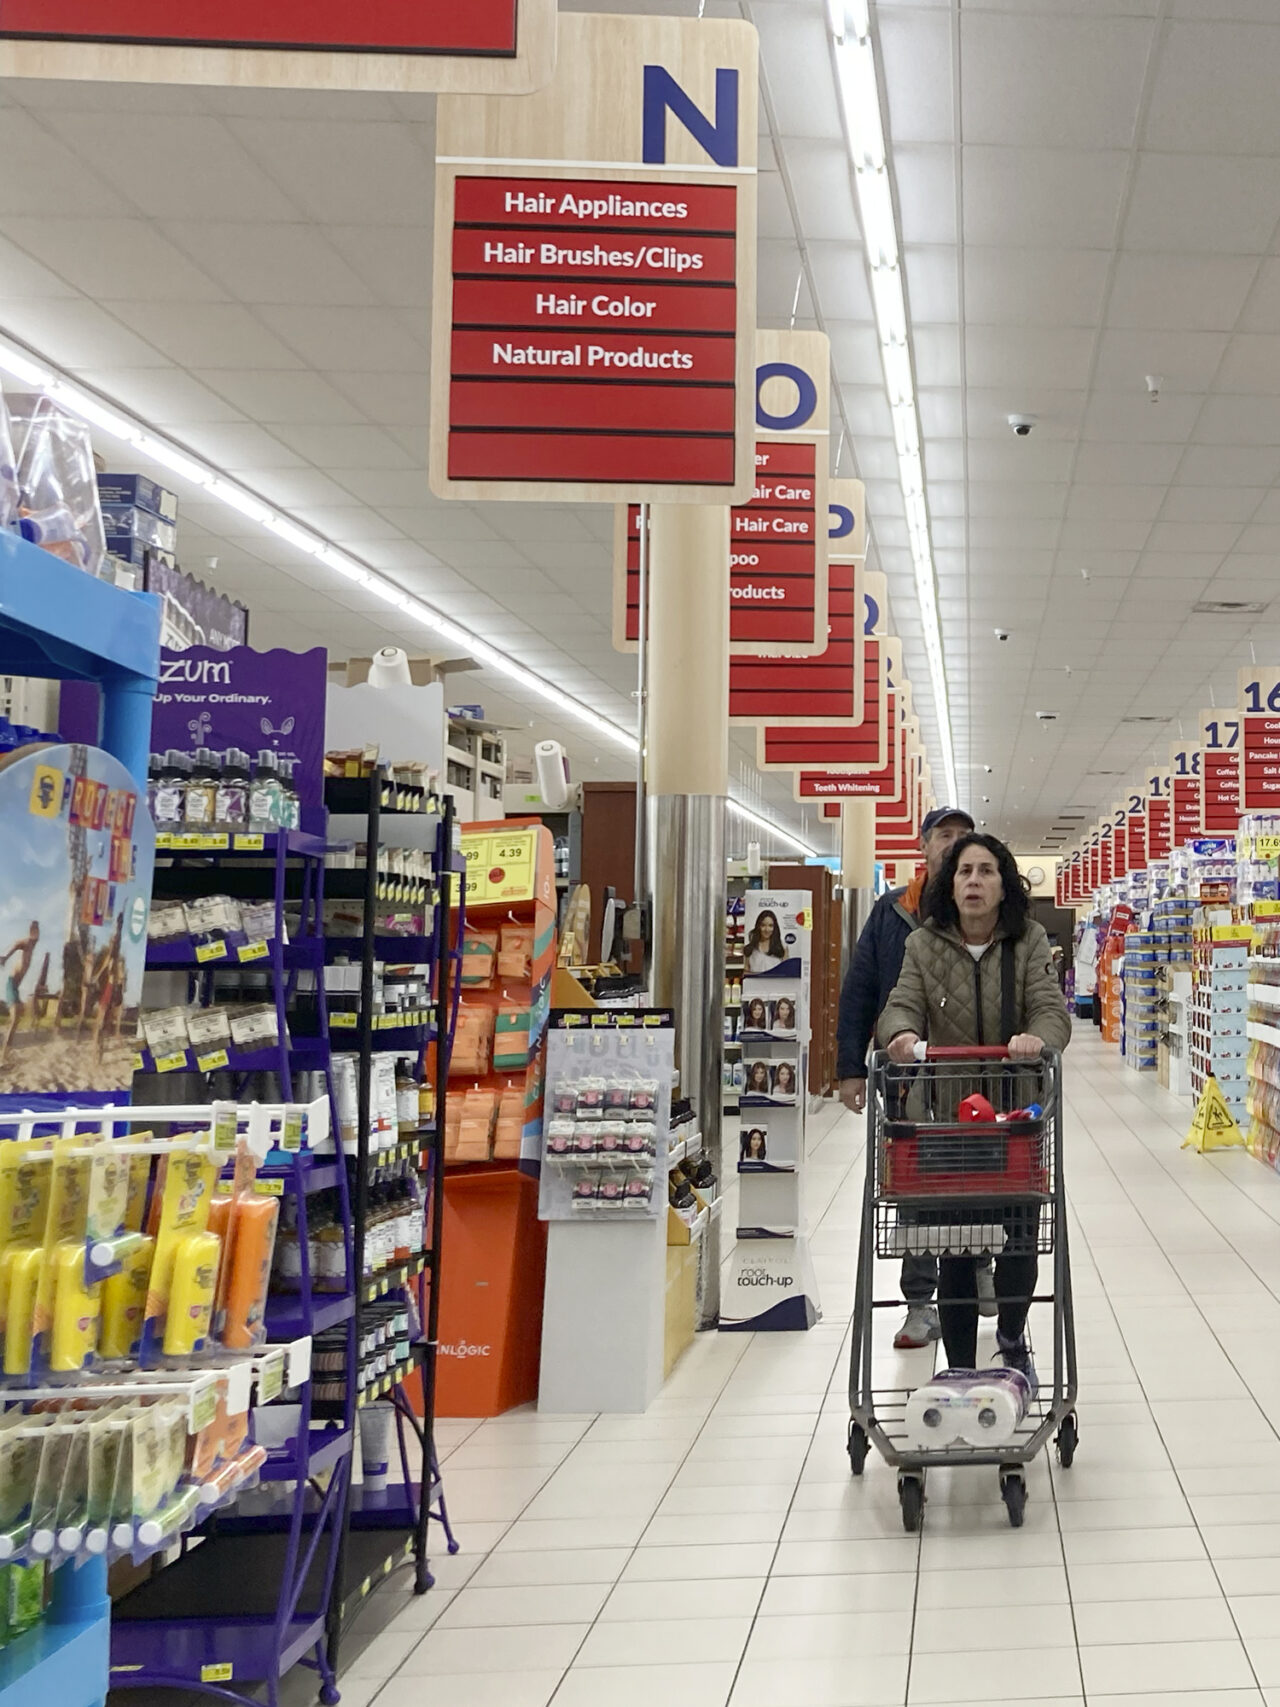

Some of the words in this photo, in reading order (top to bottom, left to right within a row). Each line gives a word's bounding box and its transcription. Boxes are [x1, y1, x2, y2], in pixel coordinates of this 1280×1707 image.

[643, 65, 738, 167] N
[504, 192, 555, 216] Hair
[559, 194, 688, 220] Appliances
[483, 242, 535, 264] Hair
[540, 244, 704, 273] Brushes/Clips
[535, 294, 587, 316] Hair
[591, 296, 656, 318] Color
[492, 343, 582, 366] Natural
[587, 345, 694, 370] Products
[752, 485, 773, 500] air
[774, 486, 812, 501] Care
[735, 517, 770, 533] Hair
[772, 518, 809, 533] Care
[730, 584, 786, 599] roducts
[174, 693, 207, 703] Your
[208, 693, 273, 705] Ordinary.
[1205, 721, 1239, 748] 17
[1249, 751, 1277, 760] Pancake
[1263, 766, 1277, 775] Salt
[814, 783, 836, 792] Teeth
[837, 783, 881, 794] Whitening
[499, 848, 522, 858] 4.39
[455, 882, 477, 893] 399
[737, 1274, 794, 1287] touch-up
